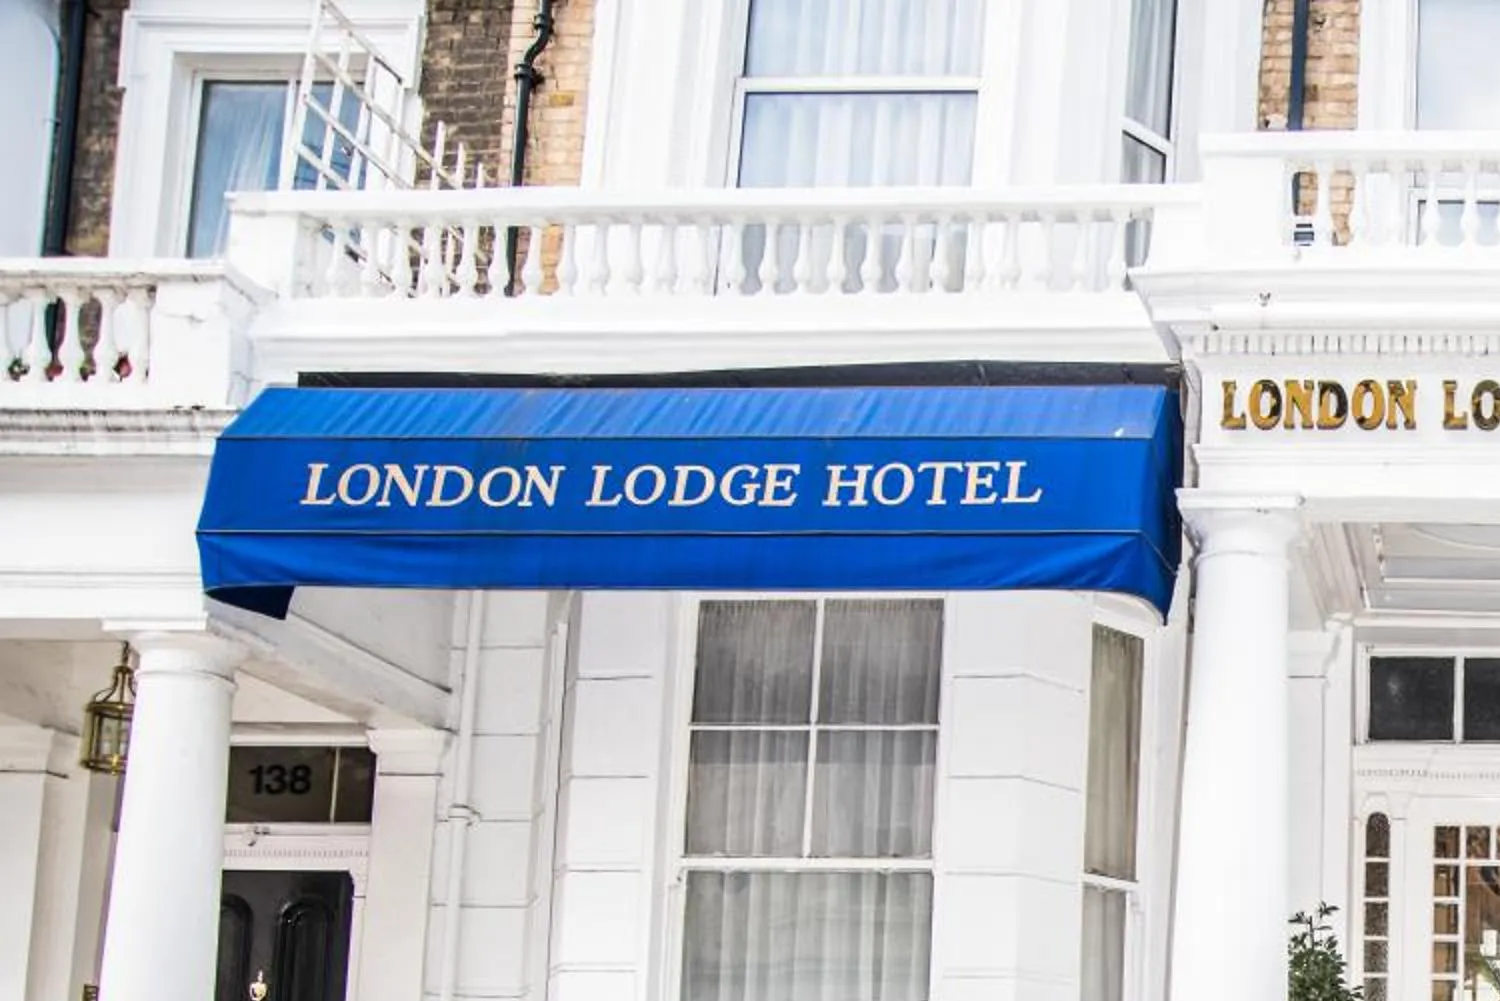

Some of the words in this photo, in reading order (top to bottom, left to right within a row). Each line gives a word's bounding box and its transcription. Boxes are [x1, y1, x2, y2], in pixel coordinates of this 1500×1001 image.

[1220, 380, 1418, 432] LONDON
[301, 463, 566, 508] LONDON
[586, 464, 801, 508] LODGE
[823, 462, 1043, 506] HOTEL
[249, 764, 312, 796] 138
